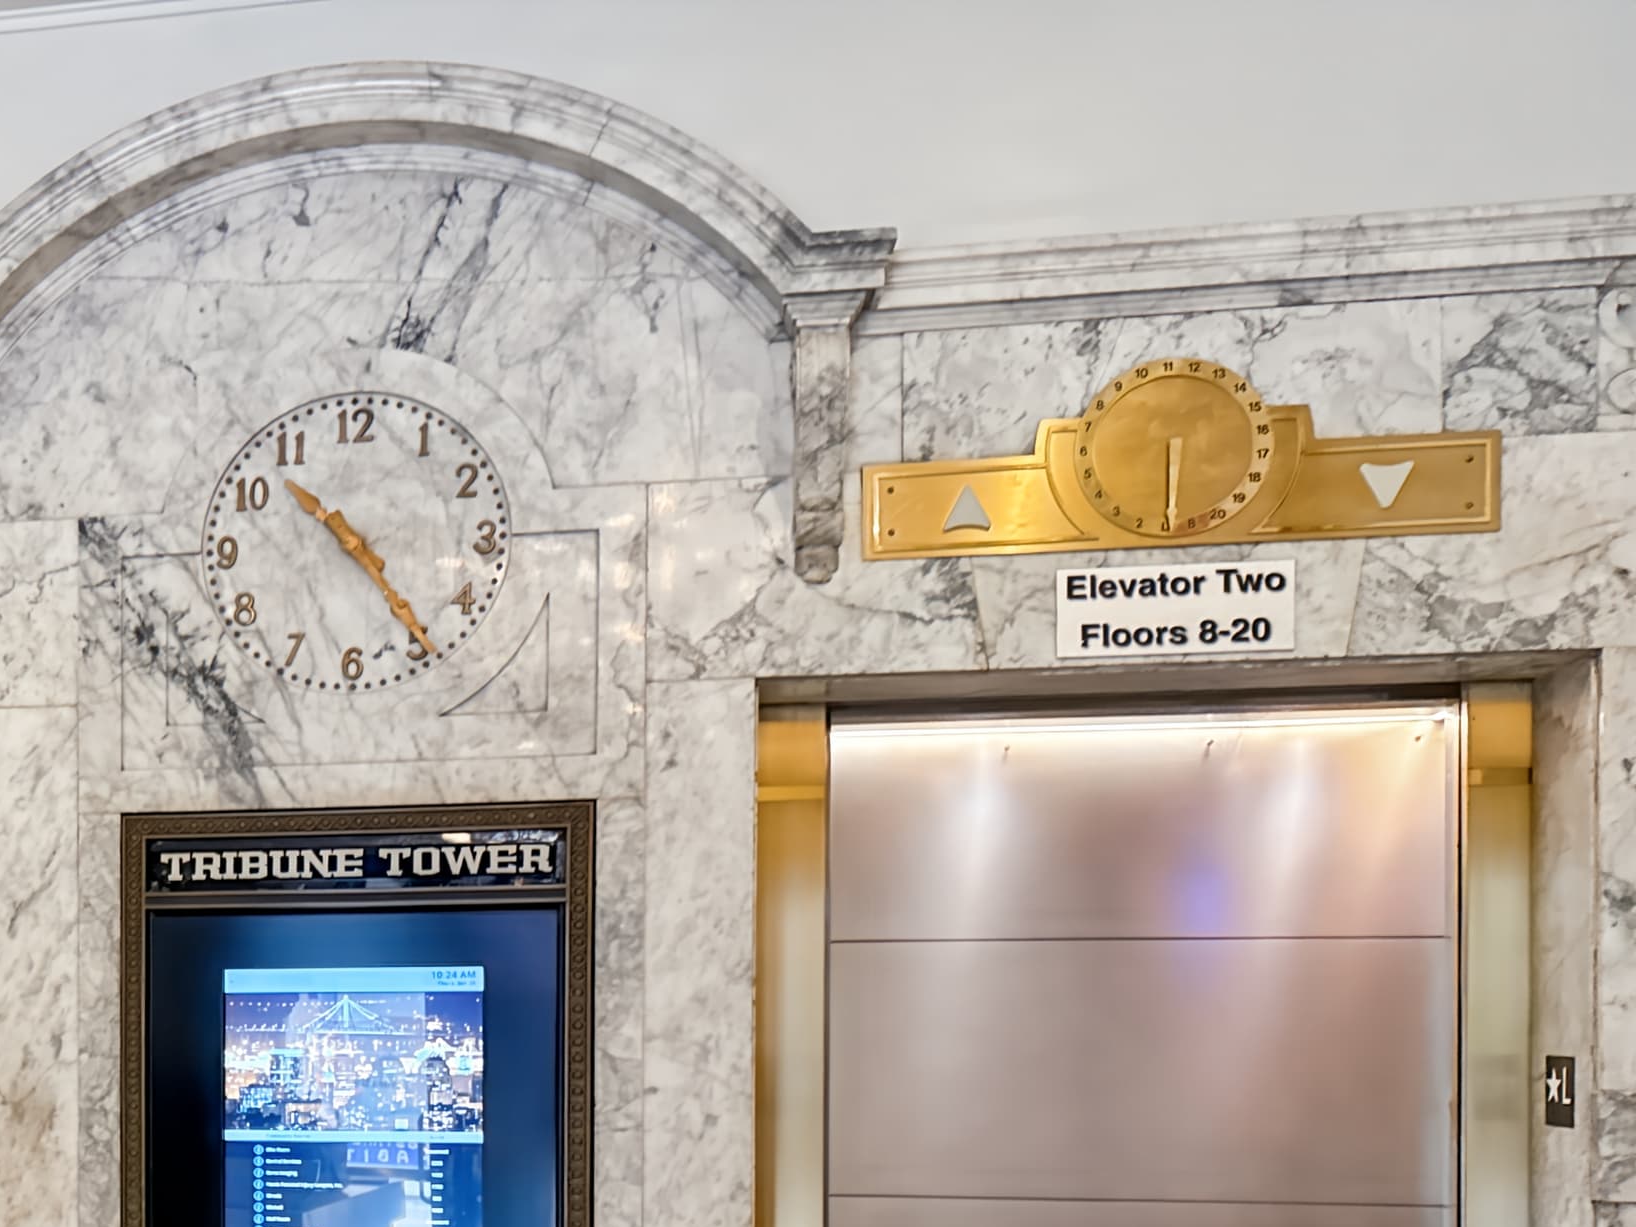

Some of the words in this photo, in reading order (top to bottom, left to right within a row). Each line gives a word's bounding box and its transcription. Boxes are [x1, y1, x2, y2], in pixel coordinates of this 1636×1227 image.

[1163, 362, 1173, 372] 11
[1188, 362, 1201, 372] 12
[1135, 368, 1148, 378] 10
[1214, 368, 1226, 379] 13
[1115, 381, 1123, 392] 9
[1234, 382, 1247, 393] 14
[1096, 400, 1104, 410] 8
[1249, 401, 1262, 412] 15
[337, 408, 374, 443] 12
[1084, 421, 1092, 432] 7
[1256, 424, 1270, 435] 16
[418, 422, 430, 456] 1
[276, 431, 305, 466] 11
[1079, 446, 1087, 456] 6
[1256, 448, 1270, 459] 17
[1084, 469, 1092, 480] 5
[1248, 472, 1261, 483] 18
[455, 463, 478, 498] 2
[235, 476, 269, 512] 10
[1095, 489, 1102, 499] 4
[1233, 492, 1245, 503] 19
[1112, 506, 1120, 516] 3
[1210, 508, 1226, 520] 20
[1136, 518, 1143, 529] 2
[473, 520, 496, 555] 3
[216, 536, 238, 570] 9
[1066, 573, 1205, 600] Elevator
[1216, 569, 1286, 593] Two
[451, 581, 476, 615] 4
[233, 592, 257, 625] 8
[1081, 623, 1188, 648] Floors
[1199, 617, 1271, 644] 8-20
[284, 633, 306, 666] 7
[341, 648, 364, 681] 6
[160, 848, 363, 882] TRIBUNE
[379, 844, 553, 876] TOWER
